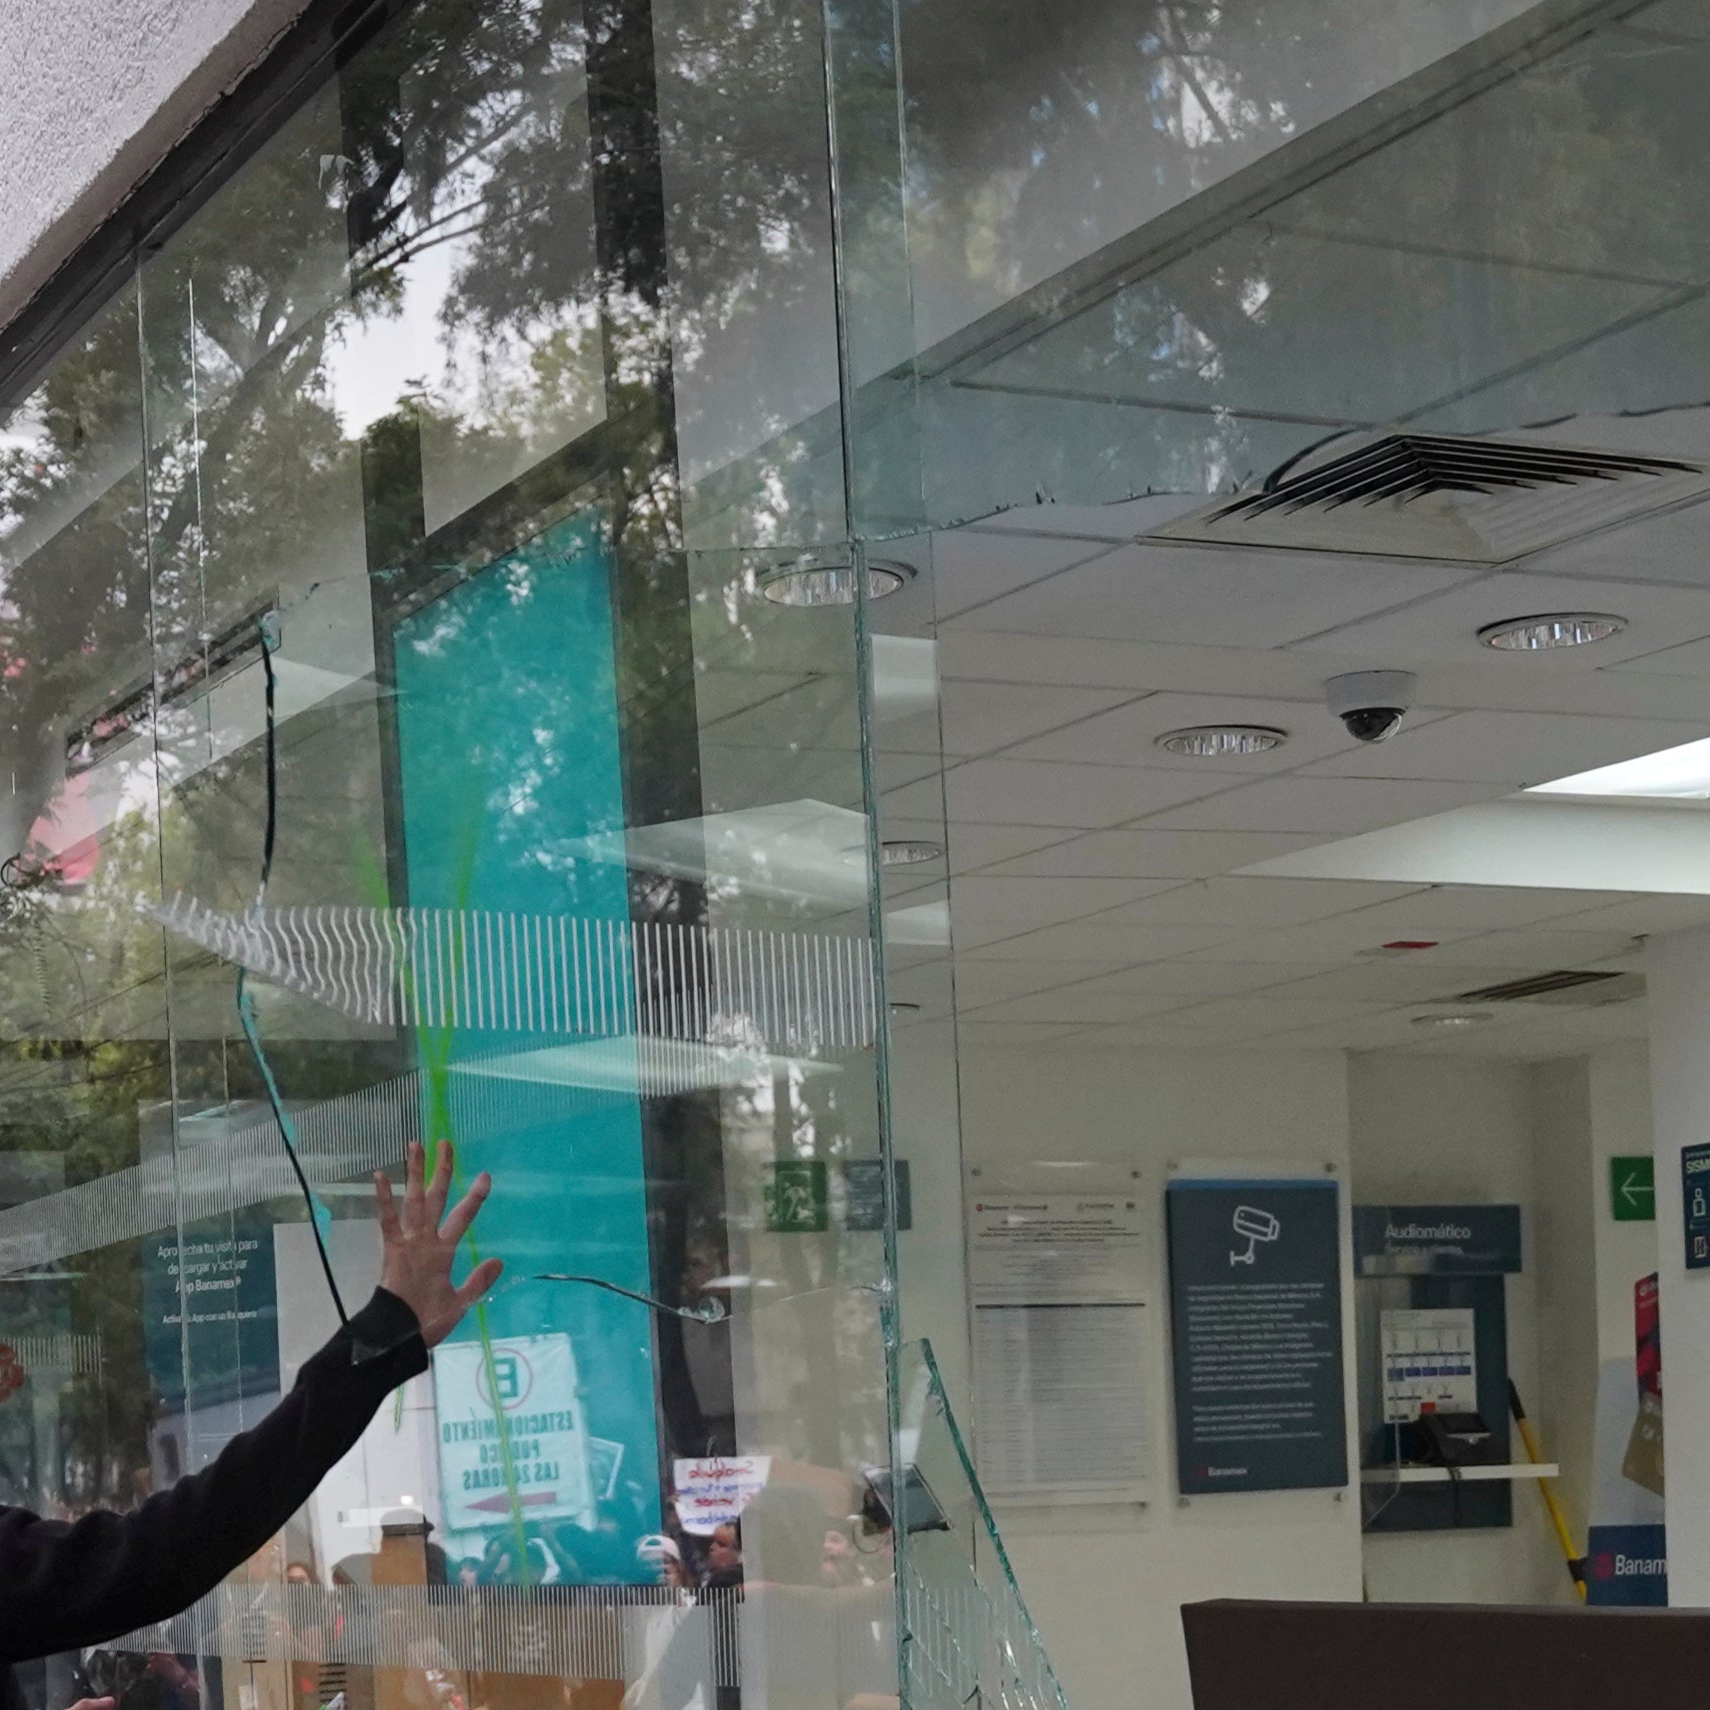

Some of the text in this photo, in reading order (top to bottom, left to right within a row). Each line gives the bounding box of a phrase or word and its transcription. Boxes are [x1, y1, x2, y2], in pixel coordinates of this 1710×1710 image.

[1385, 1223, 1472, 1239] Audiomático
[158, 1243, 203, 1260] Aproecha
[238, 1240, 258, 1253] para
[167, 1263, 210, 1275] decargar
[218, 1259, 248, 1271] actvar
[175, 1279, 194, 1293] Ap
